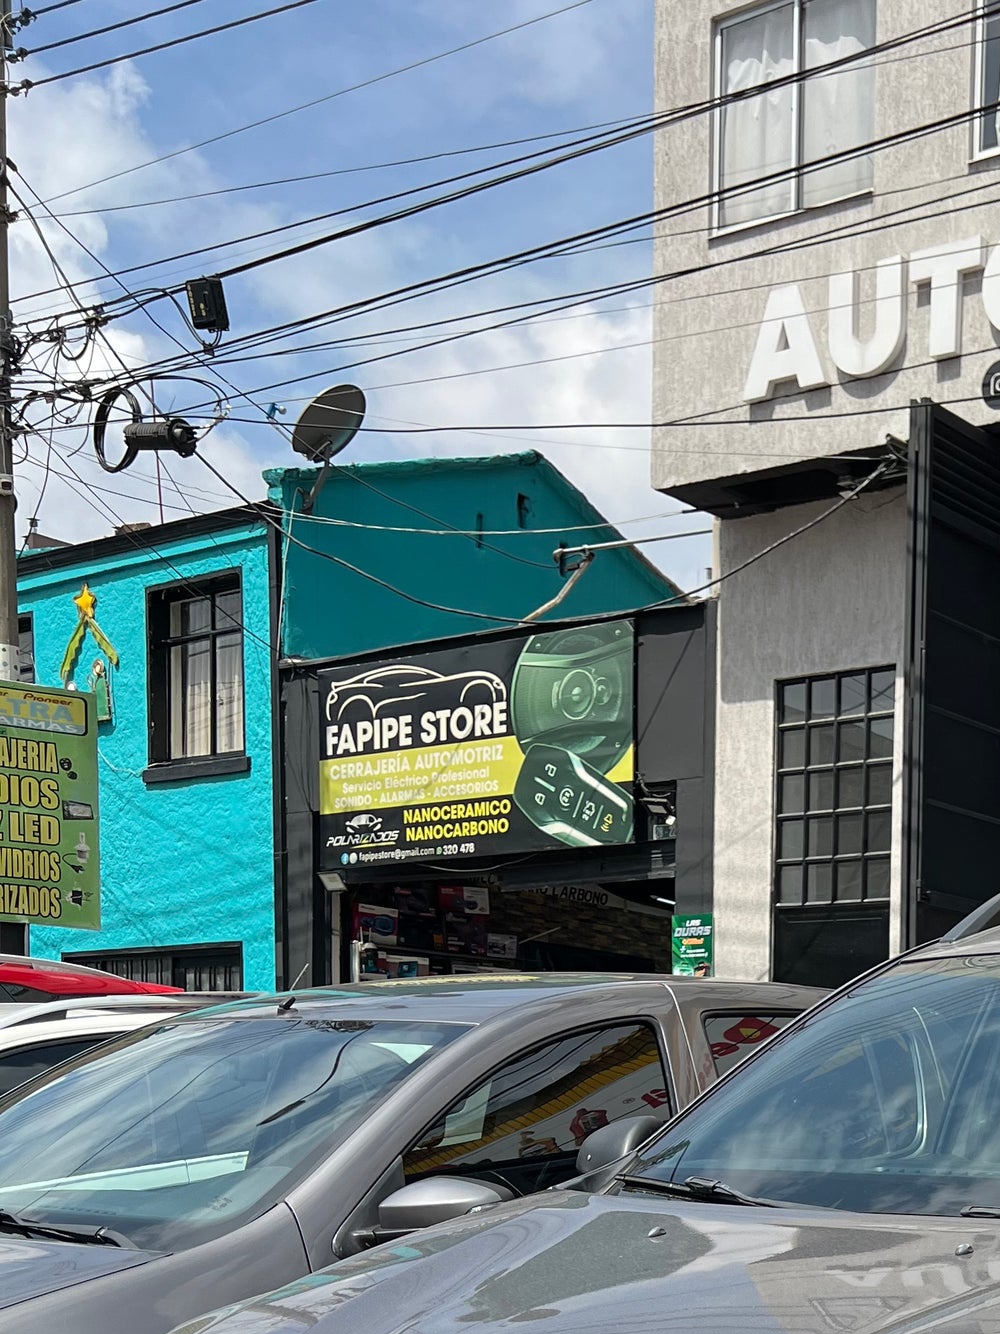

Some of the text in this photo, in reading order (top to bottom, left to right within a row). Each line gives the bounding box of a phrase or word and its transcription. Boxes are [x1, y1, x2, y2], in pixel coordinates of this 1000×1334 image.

[326, 701, 508, 756] FAPIPE STORE
[330, 744, 504, 781] CERRAJERÍA AUTOMOTRIZ
[342, 766, 490, 795] Servicio Eléctrico Profesional
[334, 780, 499, 809] SONIDO ALARMAS ACCESORIOS
[403, 798, 512, 825] NANOCERAMICO
[9, 810, 60, 846] LED
[326, 830, 400, 848] POLARIZADOS
[405, 817, 510, 842] NANOCARBONO
[359, 846, 435, 863] fapipestore@gmail.com
[443, 842, 475, 855] 320 478
[674, 926, 712, 937] DURAS
